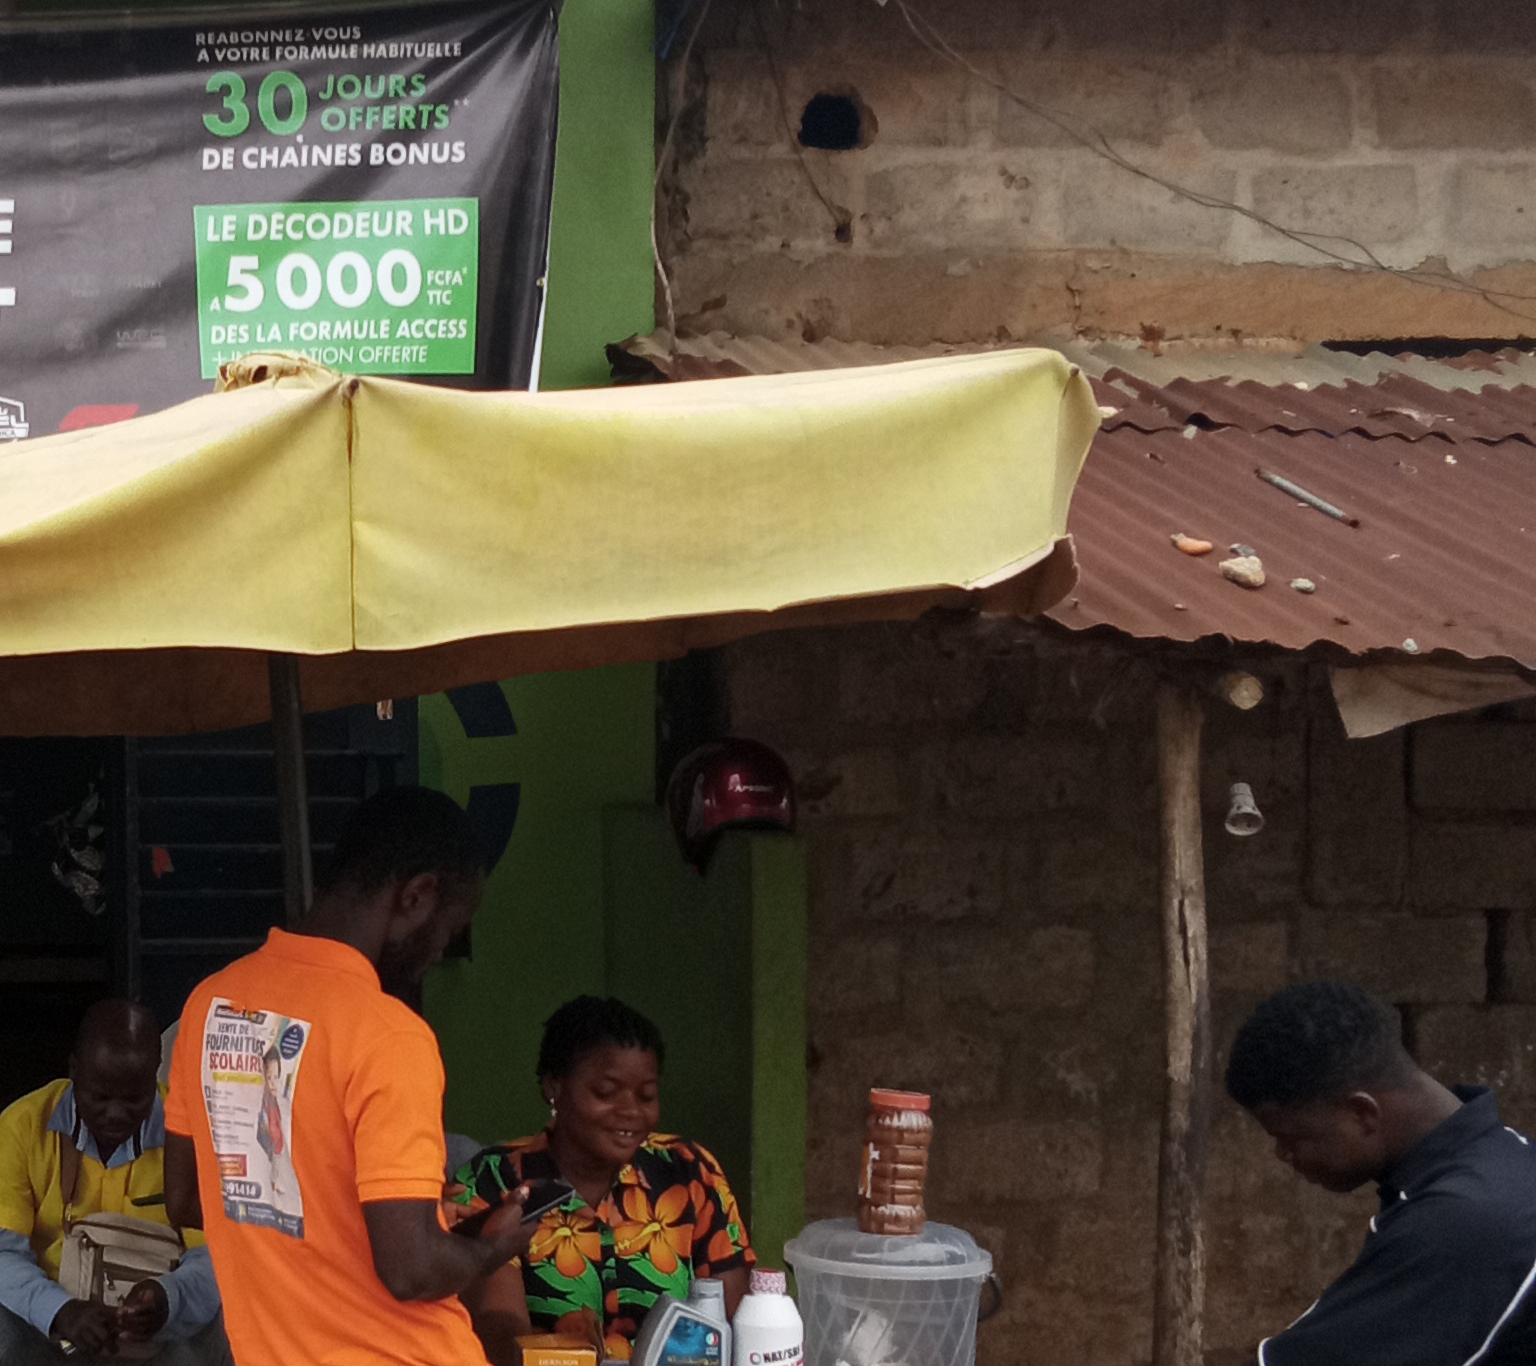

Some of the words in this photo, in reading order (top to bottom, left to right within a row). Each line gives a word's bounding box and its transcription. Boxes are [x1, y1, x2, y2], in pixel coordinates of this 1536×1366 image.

[214, 45, 270, 62] VOTRE
[275, 43, 358, 61] FORMULE
[362, 41, 462, 59] HABITUELLE
[318, 73, 427, 101] JOURS
[202, 70, 308, 137] 30
[202, 146, 234, 170] DE
[369, 141, 466, 167] BONUS
[206, 214, 237, 242] LE
[247, 210, 413, 241] DECODEUR
[423, 208, 469, 235] HD
[427, 289, 452, 306] TTC
[210, 324, 249, 345] DES
[256, 323, 282, 343] LA
[288, 319, 390, 342] FORMULE
[396, 318, 468, 339] ACCESS
[358, 344, 428, 364] OFFERTE
[239, 1024, 250, 1035] DE
